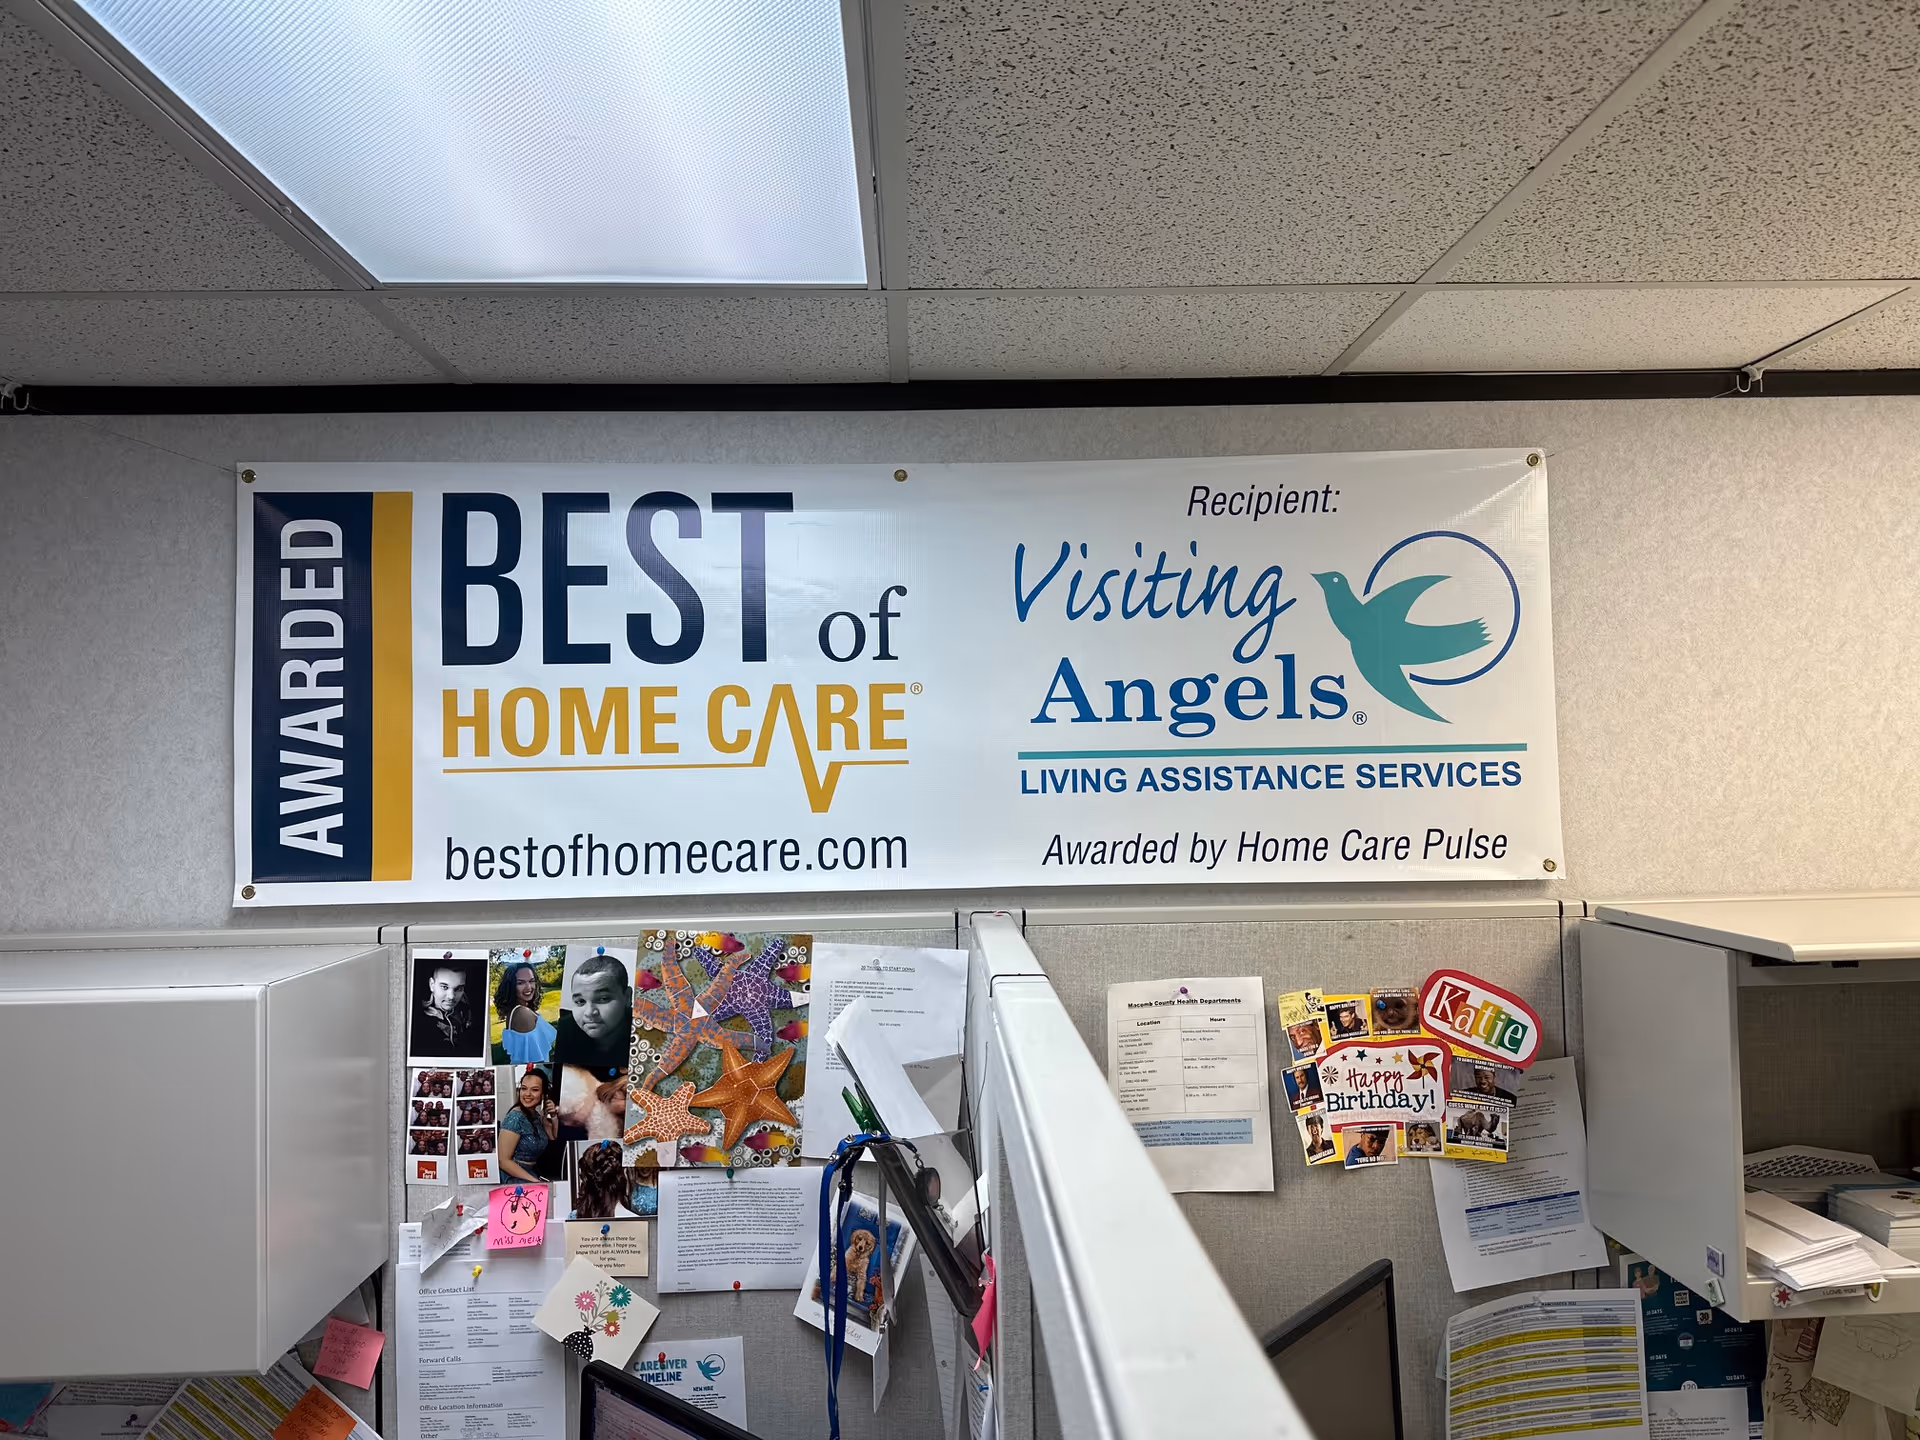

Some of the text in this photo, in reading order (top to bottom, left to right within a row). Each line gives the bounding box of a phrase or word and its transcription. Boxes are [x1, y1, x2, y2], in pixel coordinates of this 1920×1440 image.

[1187, 484, 1341, 521] Recipient:
[441, 491, 908, 666] BEST of
[1014, 540, 1297, 664] Visiting
[279, 517, 344, 858] AWARDED
[443, 685, 680, 758] HOME
[1021, 761, 1522, 795] LIVING ASSISTANCE SERVICES
[445, 834, 908, 881] bestofhomecare.com
[1042, 827, 1508, 870] Awarded by Home Care Pulse
[1127, 1001, 1153, 1009] Macomb
[1154, 999, 1176, 1007] County
[1199, 997, 1242, 1005] Departments
[1432, 984, 1526, 1052] Katie
[1136, 1019, 1161, 1027] Location
[1346, 1067, 1404, 1094] Happy
[1325, 1088, 1436, 1113] Birthday!
[418, 1356, 446, 1364] Forward
[633, 1358, 687, 1372] CAREGIVER
[640, 1371, 682, 1382] TIMELINE
[438, 1403, 466, 1411] Location
[466, 1402, 503, 1410] Information
[420, 1432, 439, 1440] Other
